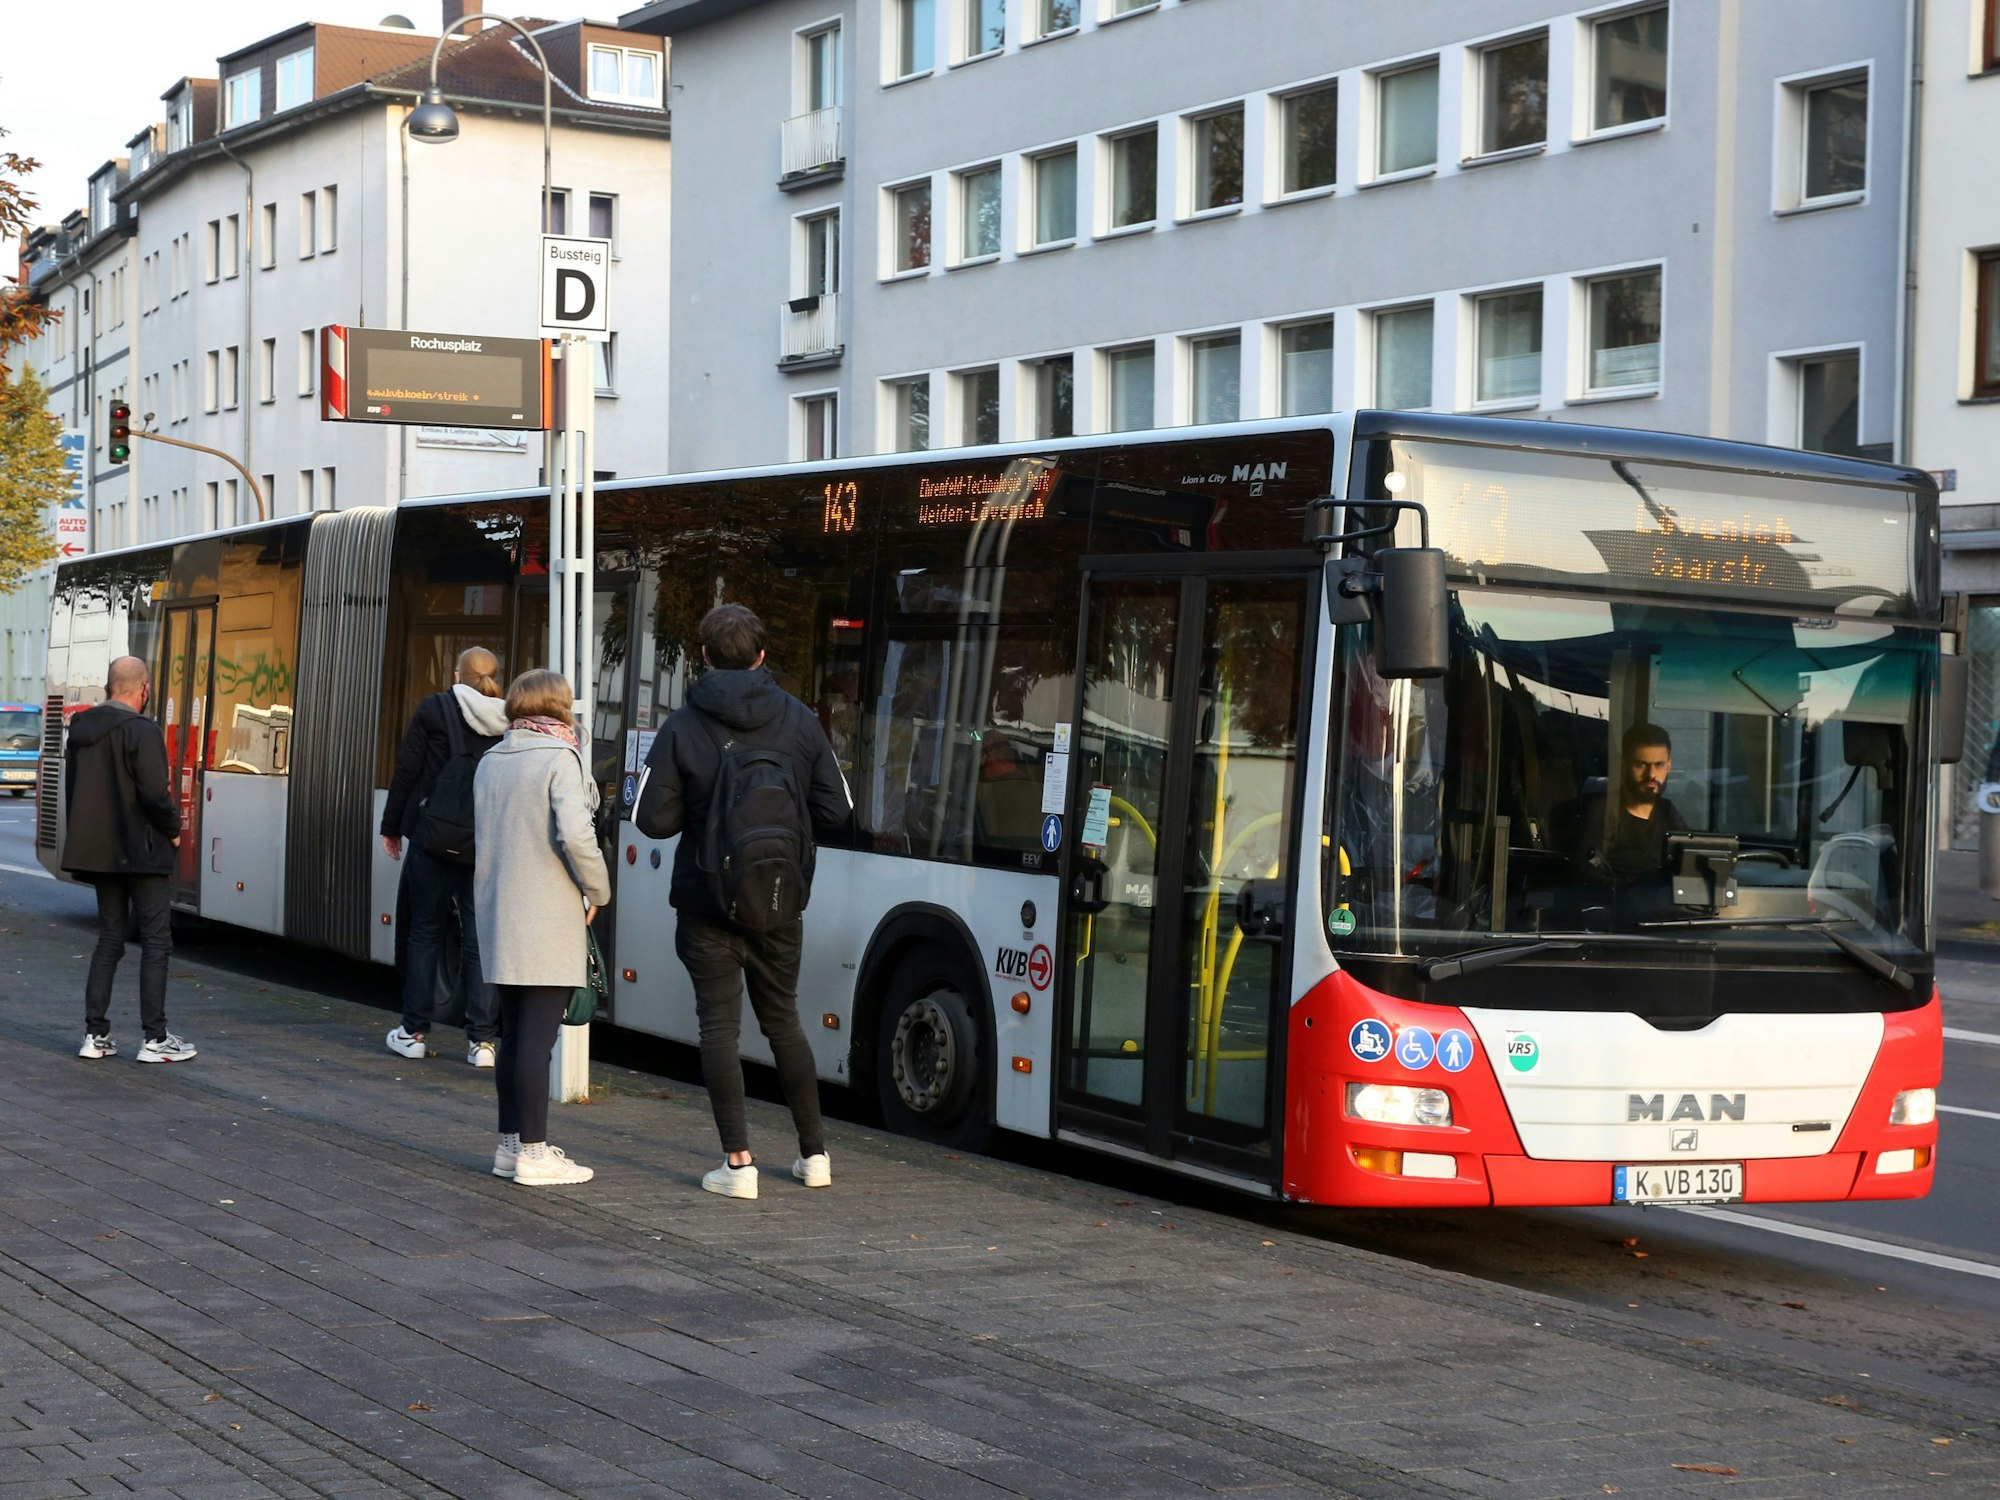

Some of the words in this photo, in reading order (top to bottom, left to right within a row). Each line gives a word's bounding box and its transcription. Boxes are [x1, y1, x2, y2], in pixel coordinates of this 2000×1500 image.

[550, 246, 601, 265] Bussteig
[556, 268, 595, 321] D
[410, 336, 482, 353] Rochusplatz
[1208, 473, 1227, 484] City
[1232, 462, 1287, 482] MAN
[824, 481, 858, 533] 143
[1651, 546, 1776, 587] Saarstr.
[1022, 852, 1041, 866] EEV
[1125, 884, 1152, 894] MA
[1338, 910, 1346, 923] 4
[996, 948, 1028, 977] KVB
[1508, 1042, 1531, 1054] VRS
[1627, 1094, 1746, 1121] MAN
[1617, 1186, 1624, 1195] D
[1636, 1170, 1649, 1196] K
